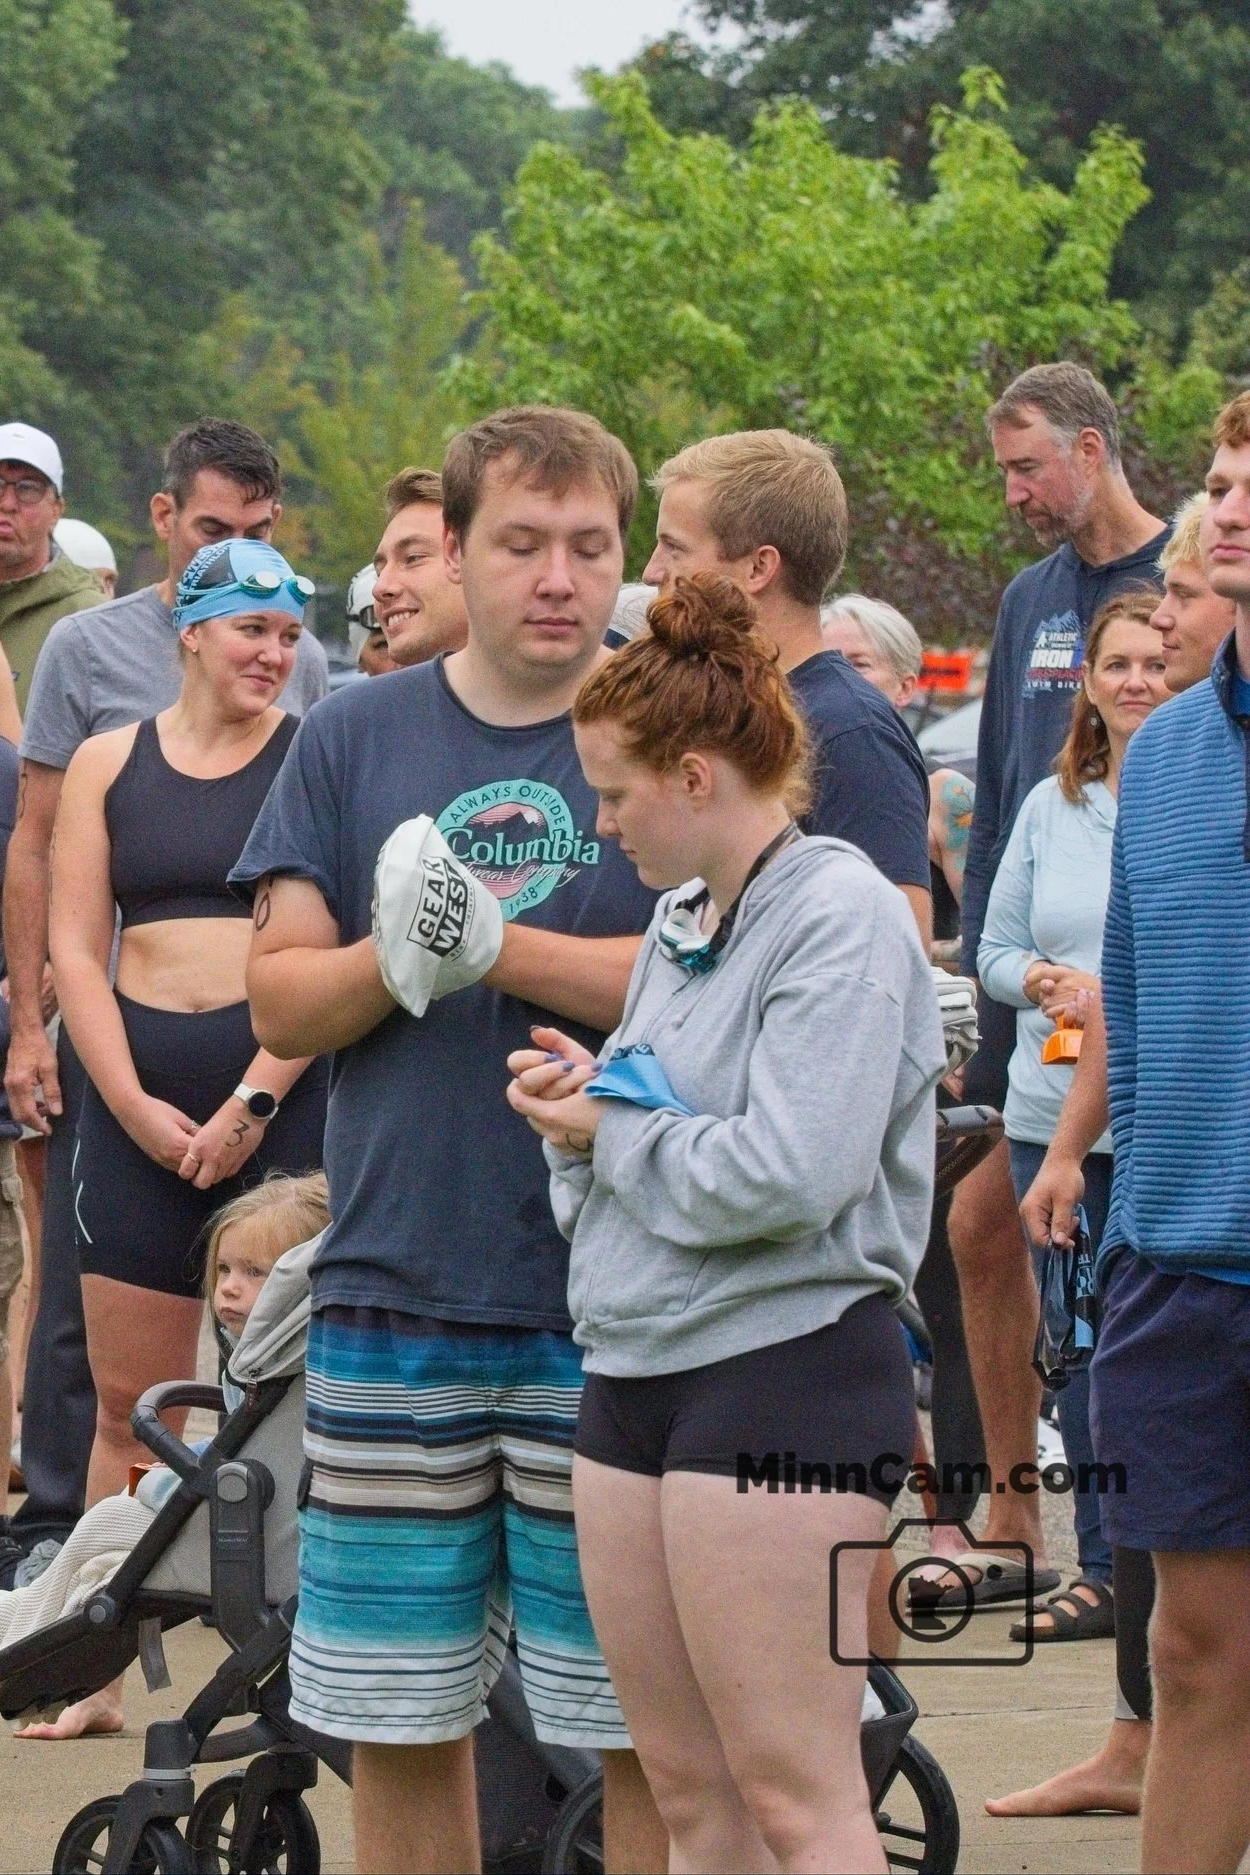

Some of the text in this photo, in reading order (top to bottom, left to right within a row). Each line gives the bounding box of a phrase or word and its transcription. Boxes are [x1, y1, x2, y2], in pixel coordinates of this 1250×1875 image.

[1030, 650, 1074, 668] IRON
[450, 785, 566, 825] ALWAYS OUTSIDE
[448, 828, 600, 866] Columbia
[417, 858, 445, 938] GEAR
[436, 868, 468, 949] WEST
[510, 887, 538, 914] 1938
[225, 1118, 250, 1147] 3
